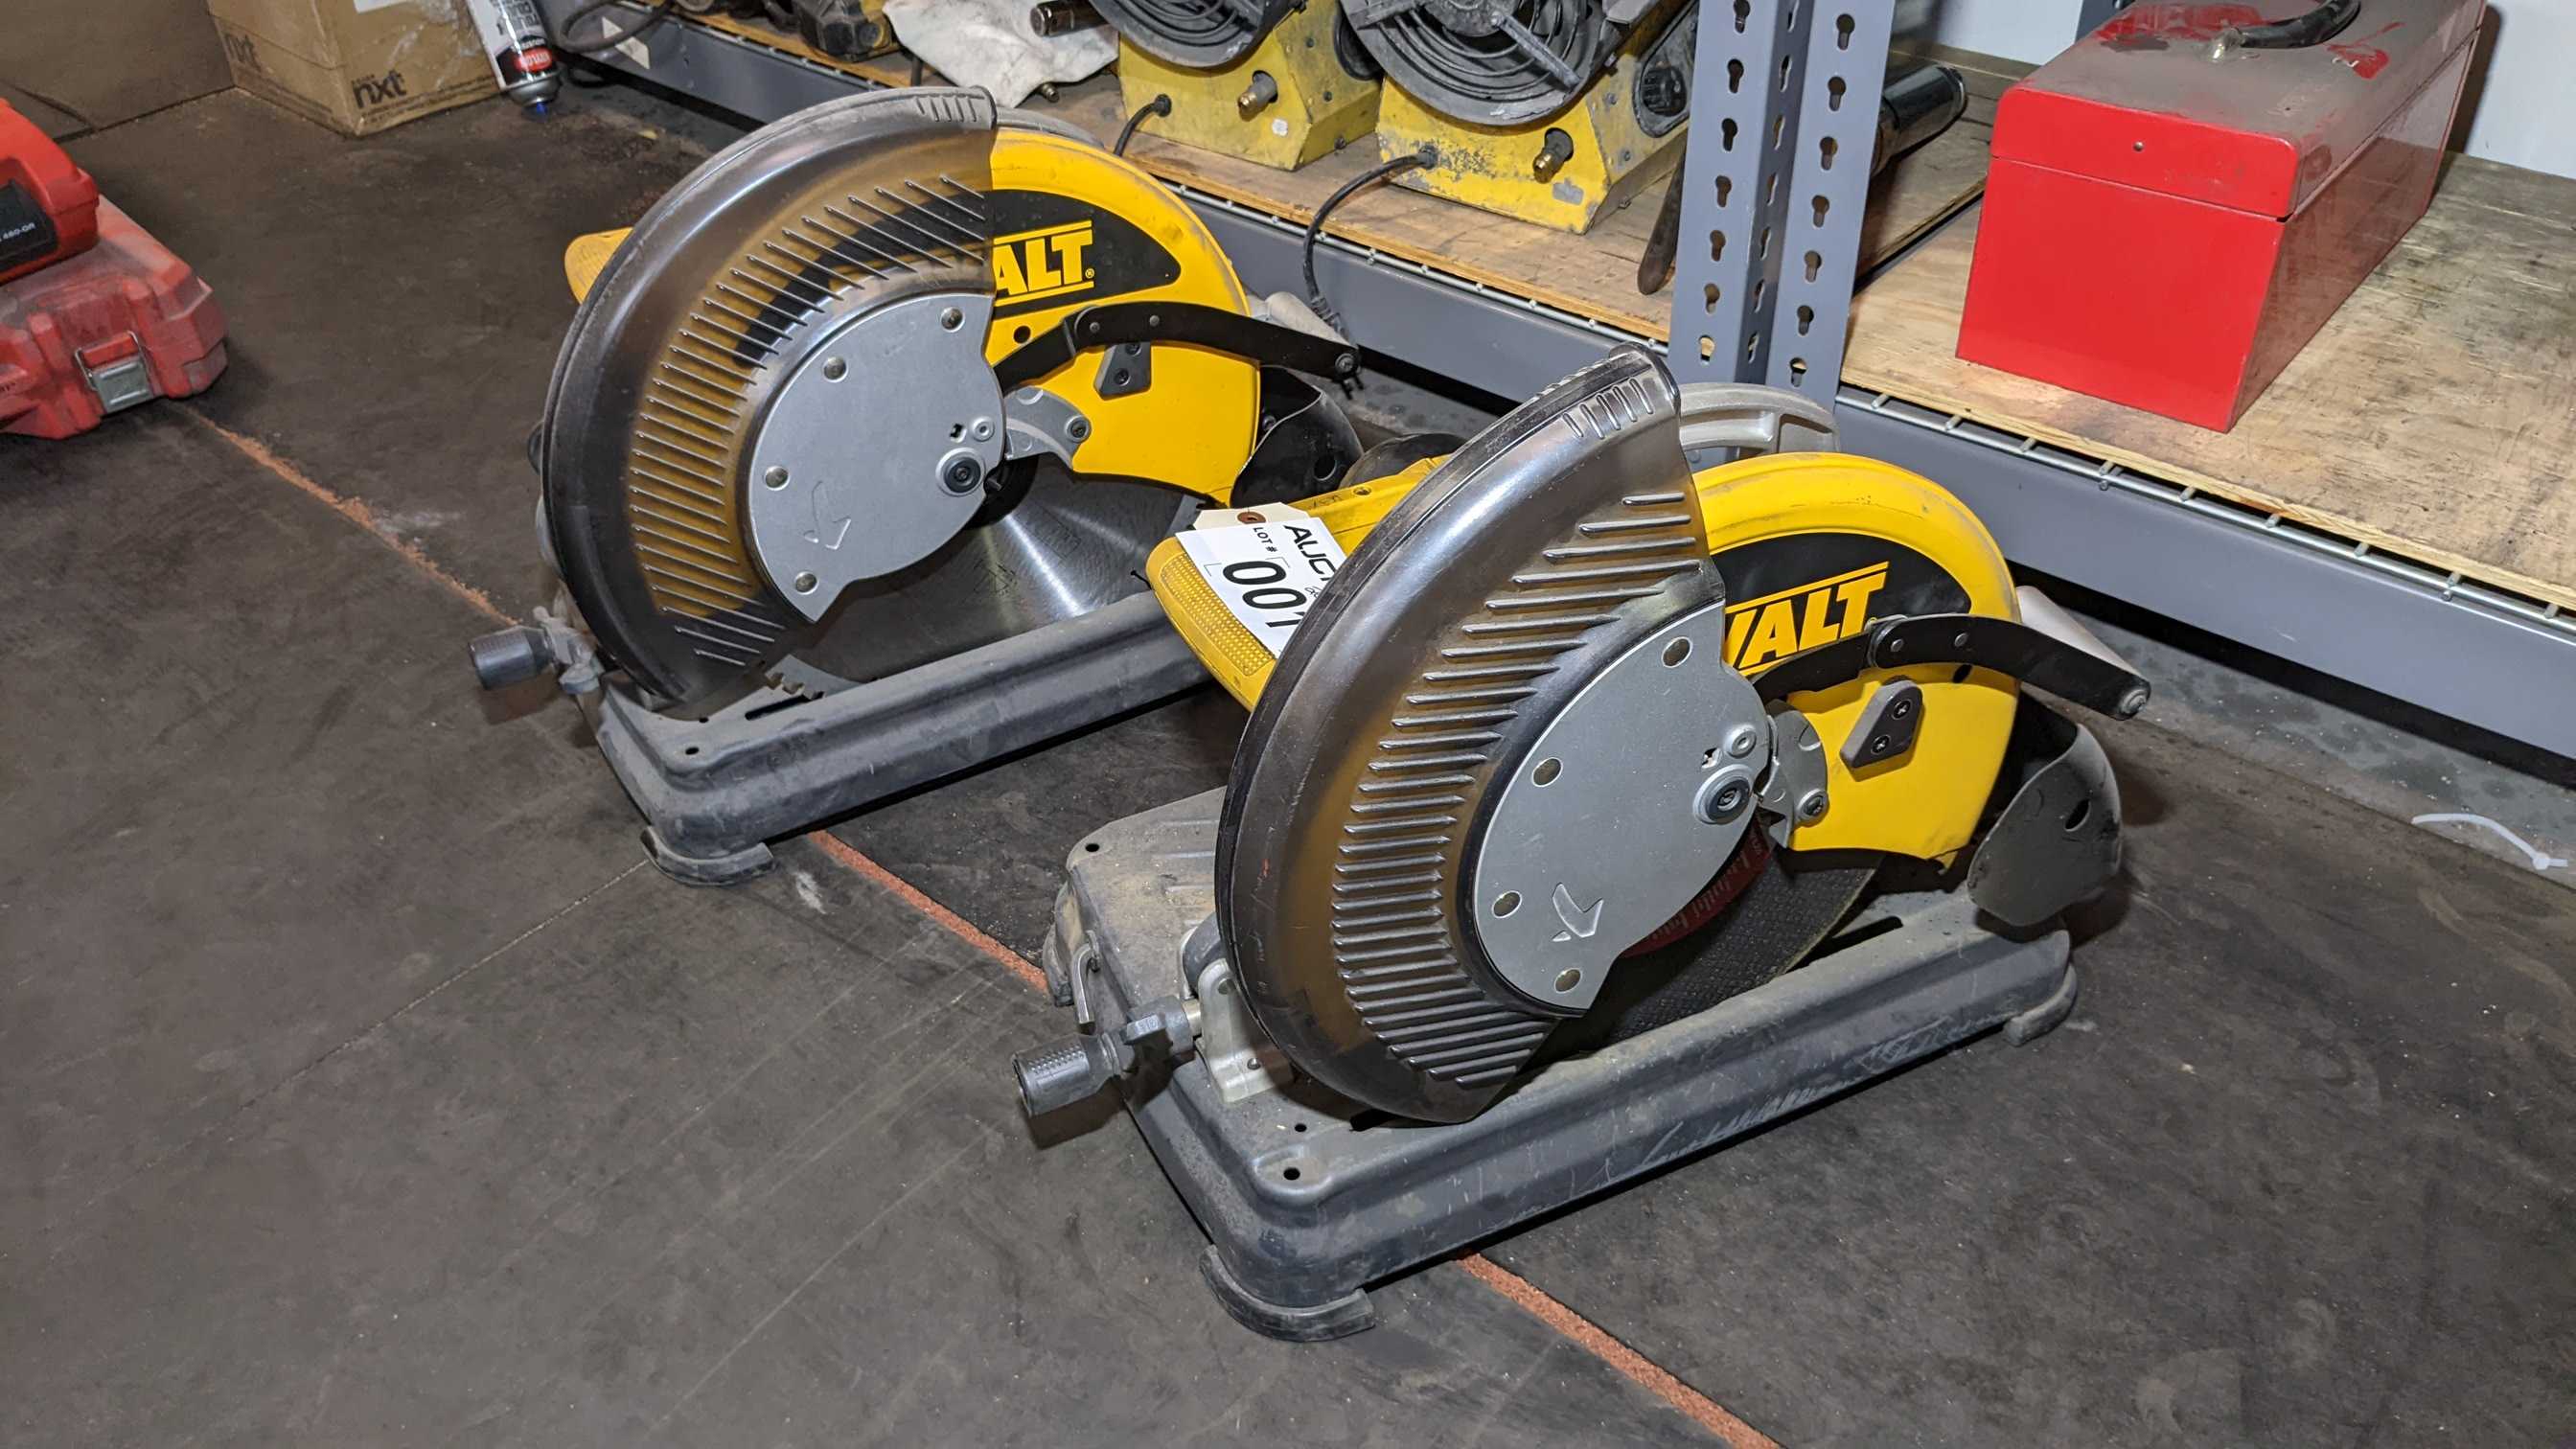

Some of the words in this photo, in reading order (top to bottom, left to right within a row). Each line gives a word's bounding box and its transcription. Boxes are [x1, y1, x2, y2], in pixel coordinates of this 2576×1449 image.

[352, 70, 407, 109] nxt
[993, 229, 1093, 295] ALT
[1254, 527, 1274, 544] LOT
